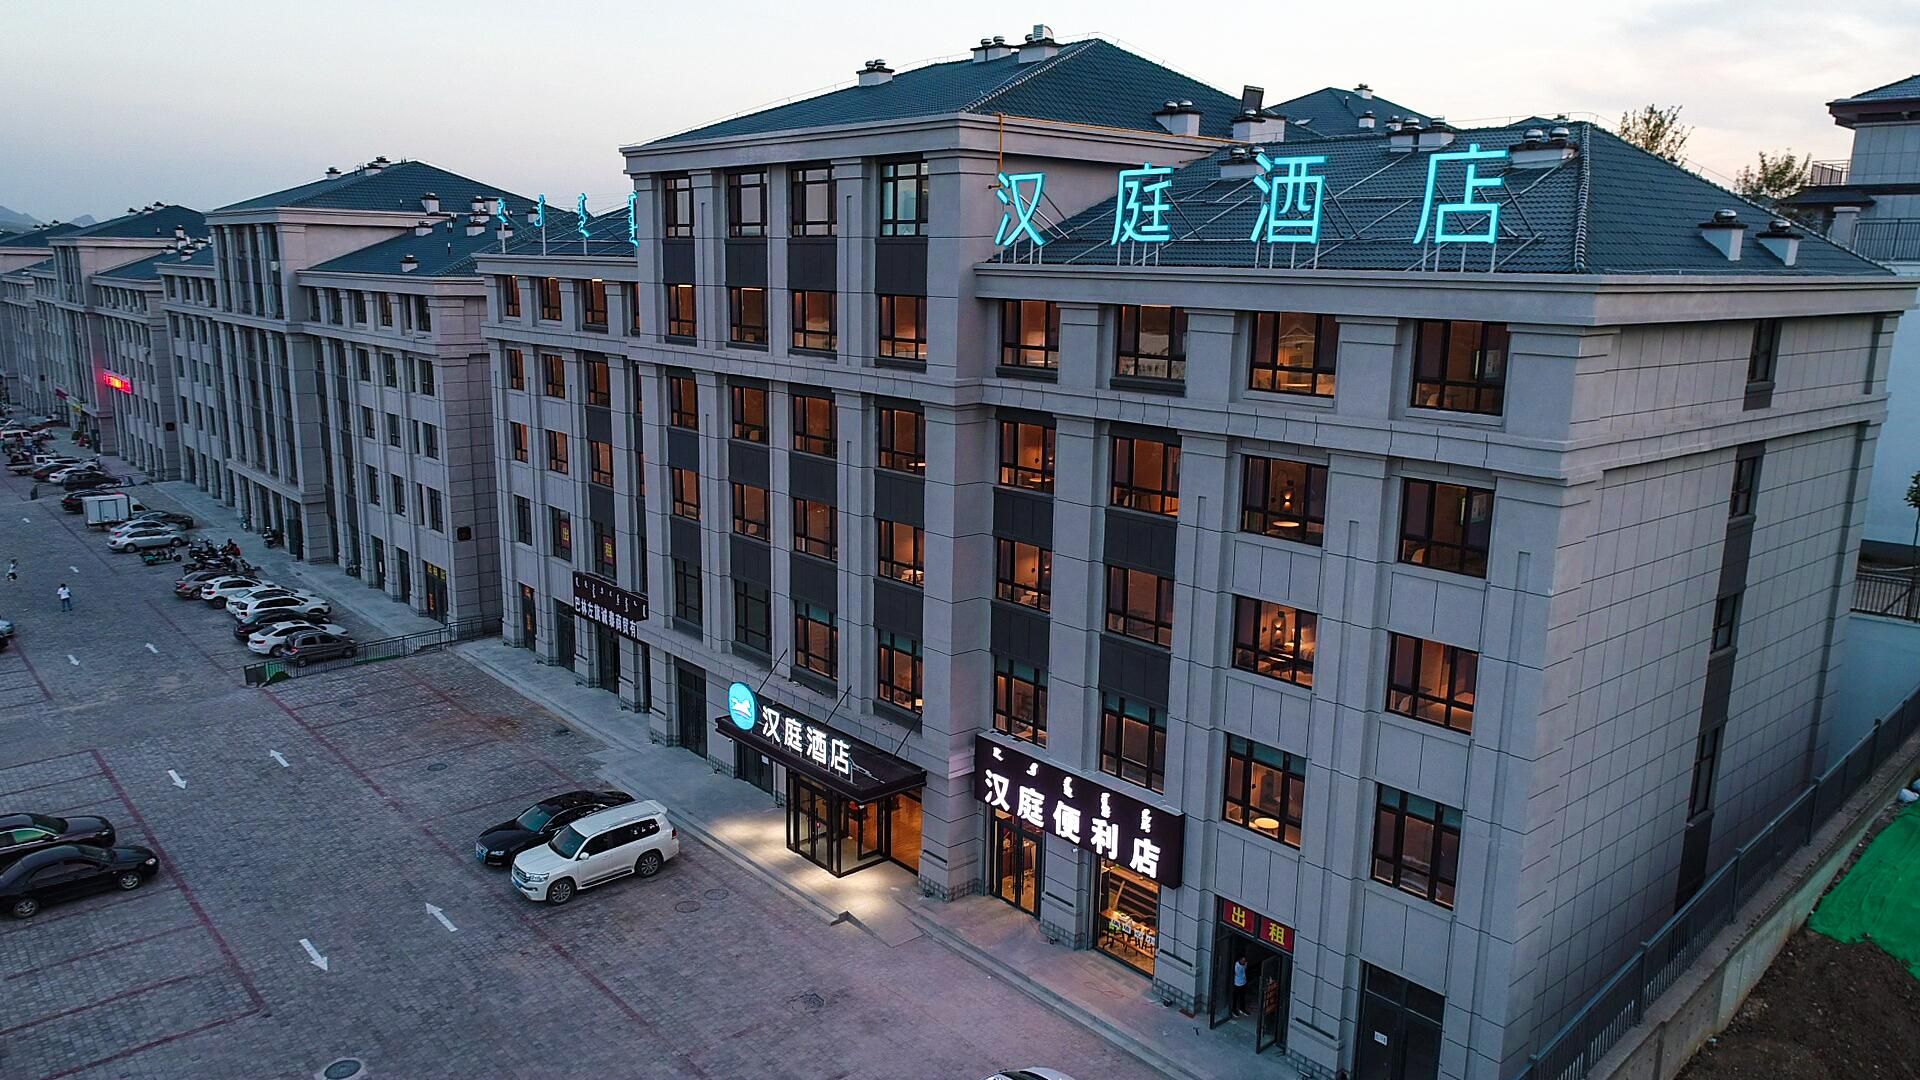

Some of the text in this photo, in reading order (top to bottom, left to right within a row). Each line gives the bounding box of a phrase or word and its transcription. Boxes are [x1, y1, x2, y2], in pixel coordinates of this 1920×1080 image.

[995, 143, 1510, 246] 汉庭酒店
[762, 705, 850, 775] 汉庭酒店
[985, 769, 1161, 879] 汉庭便利店
[1231, 905, 1285, 946] 出租
